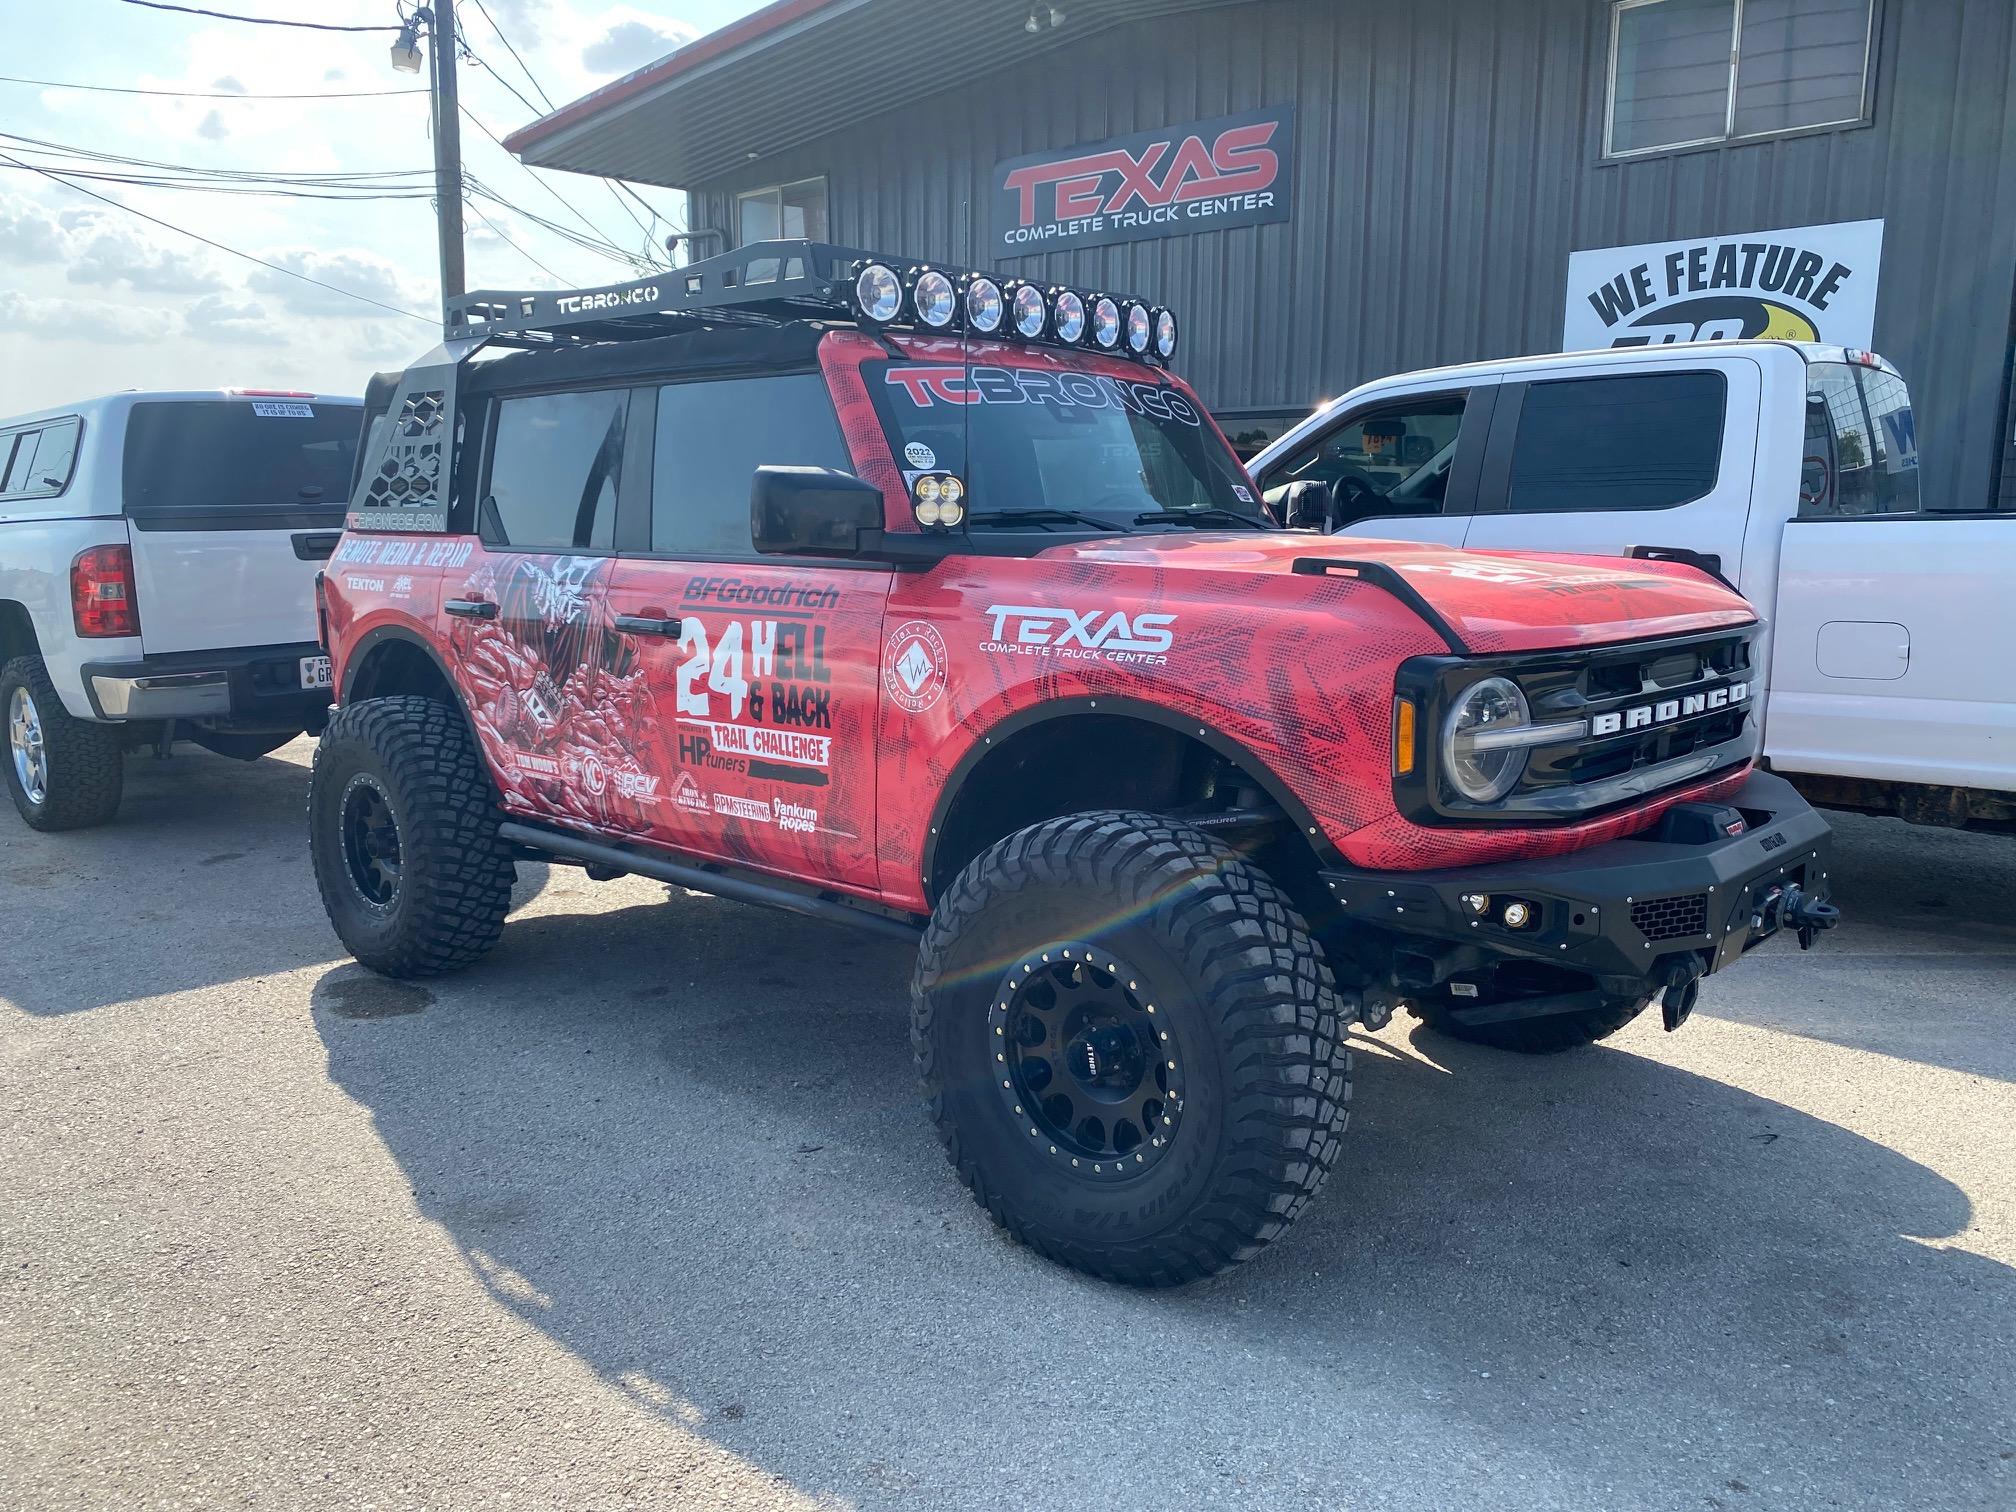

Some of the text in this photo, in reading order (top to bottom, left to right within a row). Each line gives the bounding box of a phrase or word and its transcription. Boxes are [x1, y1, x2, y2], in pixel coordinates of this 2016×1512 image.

[1003, 120, 1279, 226] TEXAS
[1004, 191, 1274, 244] COMPLETE TRUCK CENTER
[557, 286, 659, 315] TCBRONCO
[1587, 243, 1853, 328] WE FEATURE
[886, 366, 1200, 427] TCBRONCO
[346, 512, 445, 531] TCBRONCOS.COM
[336, 539, 473, 567] REMOTE MEDIA & REPAIR
[347, 577, 384, 592] TEKTON
[683, 576, 840, 609] BFGoodrich
[985, 605, 1179, 653] TEXAS
[676, 616, 748, 720] 24
[751, 620, 832, 684] HELL
[979, 642, 1168, 666] COMPLETE TRUCK CENTER
[318, 667, 333, 682] GR
[750, 681, 832, 730] & BACK
[1592, 682, 1748, 736] BRONCO
[714, 725, 824, 763] TRAIL CHALLENGE
[585, 760, 603, 791] KC
[623, 772, 660, 795] RCV
[780, 815, 815, 833] Ropes
